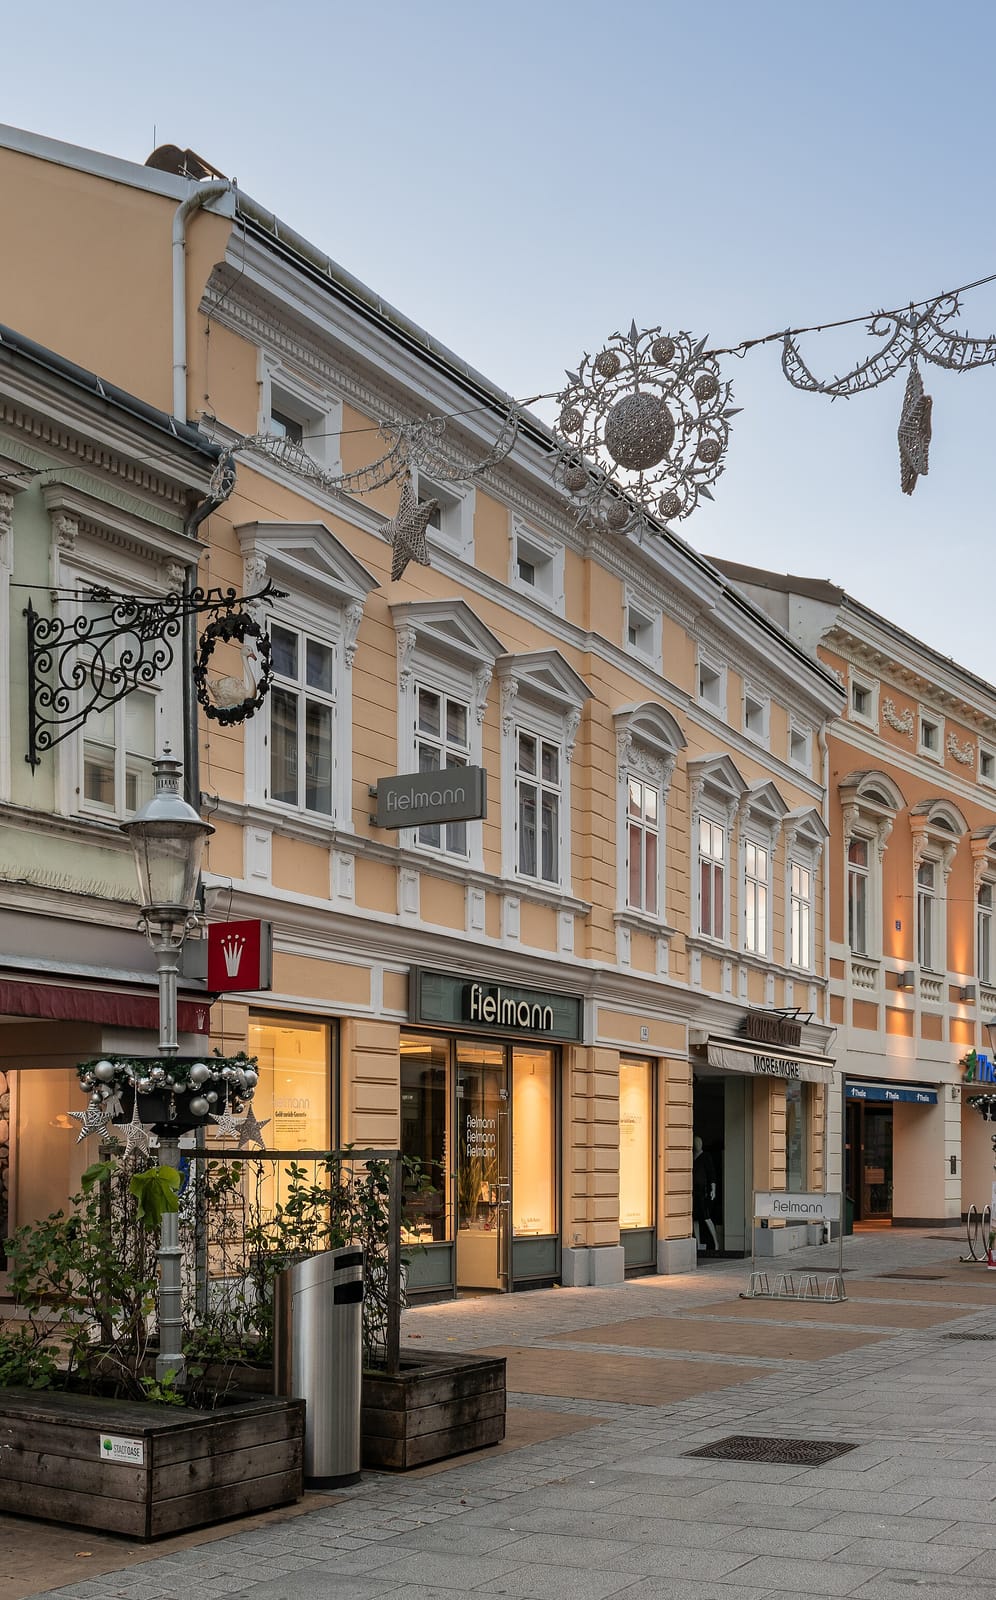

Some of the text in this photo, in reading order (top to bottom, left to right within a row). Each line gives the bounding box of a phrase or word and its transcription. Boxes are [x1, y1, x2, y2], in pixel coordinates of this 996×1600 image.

[386, 786, 465, 812] fielmann
[470, 984, 554, 1030] fielmann
[753, 1055, 800, 1077] MORE&MORE
[466, 1114, 496, 1128] fielmann
[466, 1128, 496, 1143] fielmann
[466, 1143, 496, 1157] fielmann
[773, 1199, 823, 1213] fielmann
